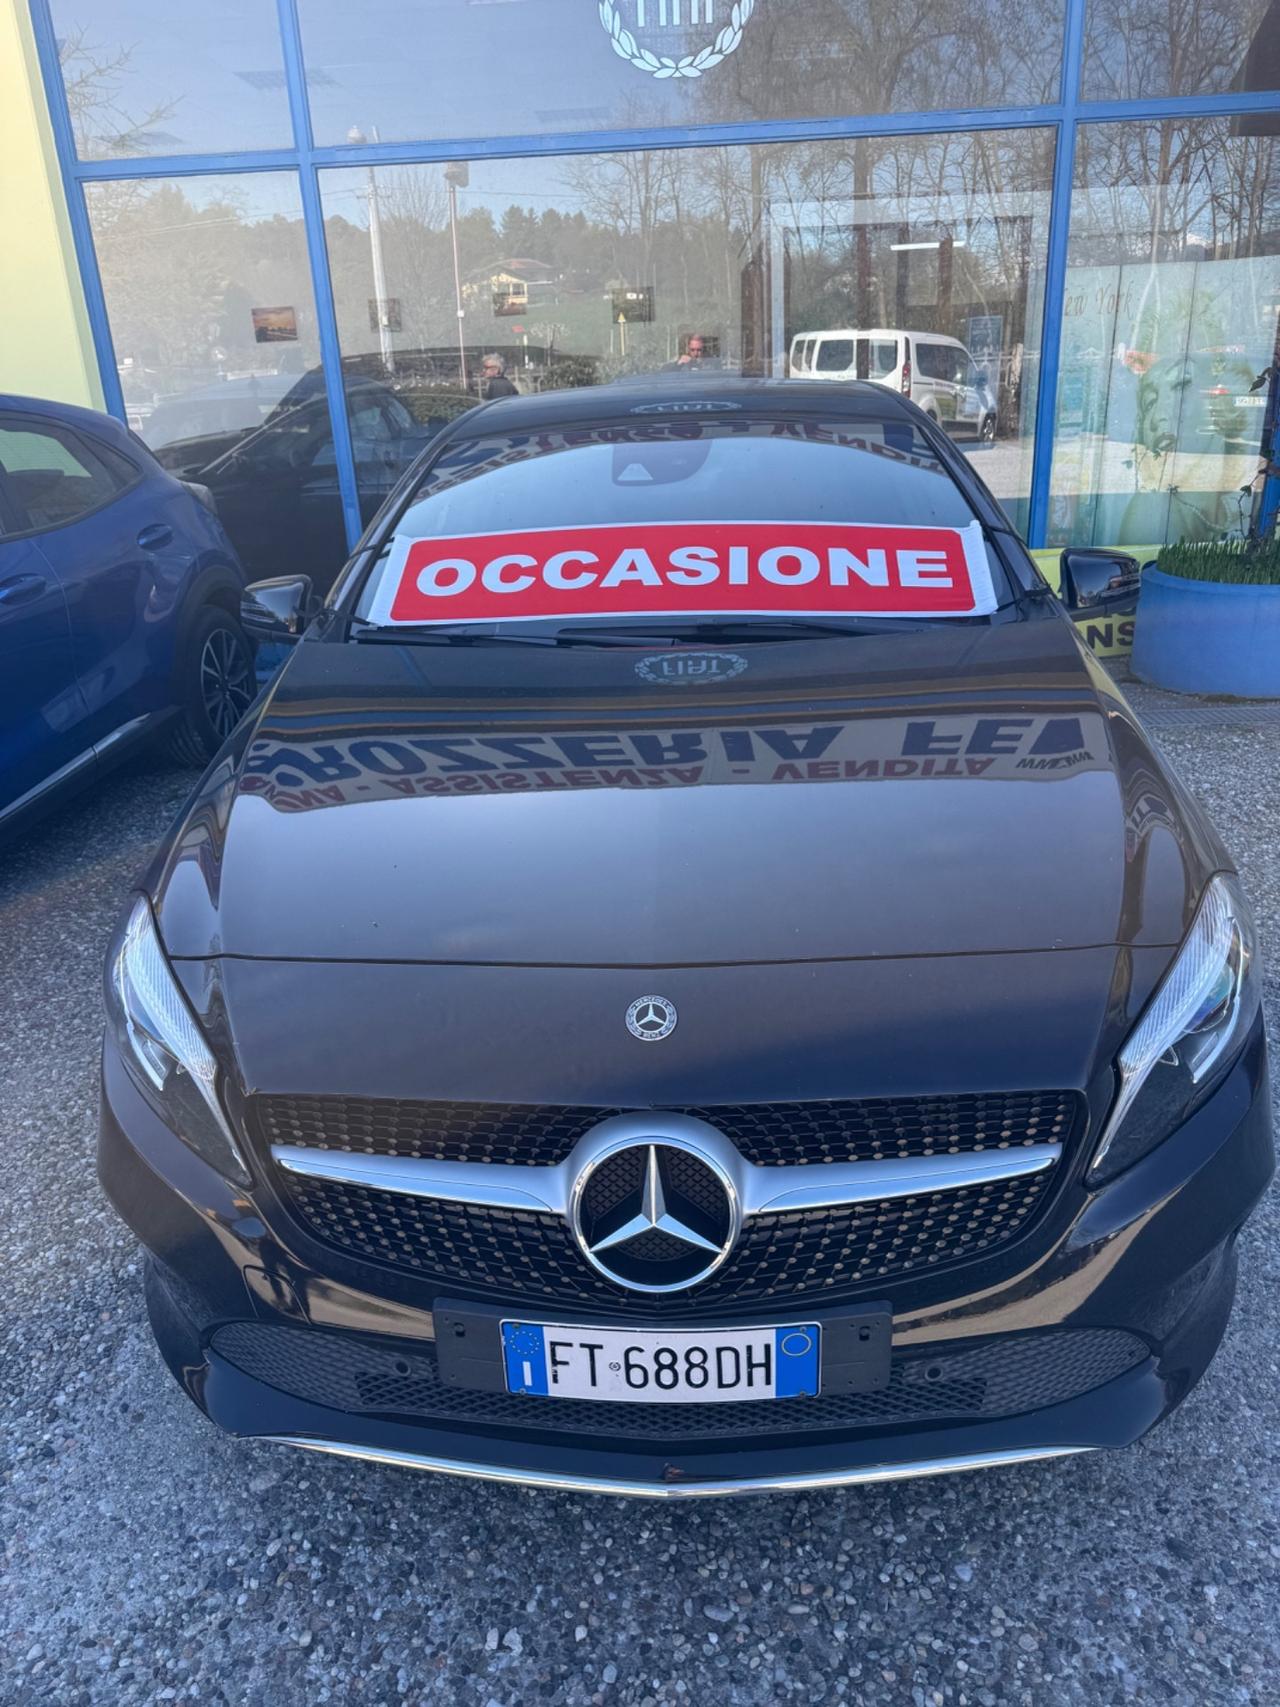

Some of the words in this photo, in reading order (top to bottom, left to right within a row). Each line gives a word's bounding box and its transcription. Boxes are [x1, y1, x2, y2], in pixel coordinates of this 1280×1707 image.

[415, 545, 954, 598] OCCASIONE
[549, 1341, 604, 1388] FT
[623, 1342, 773, 1391] 688DH
